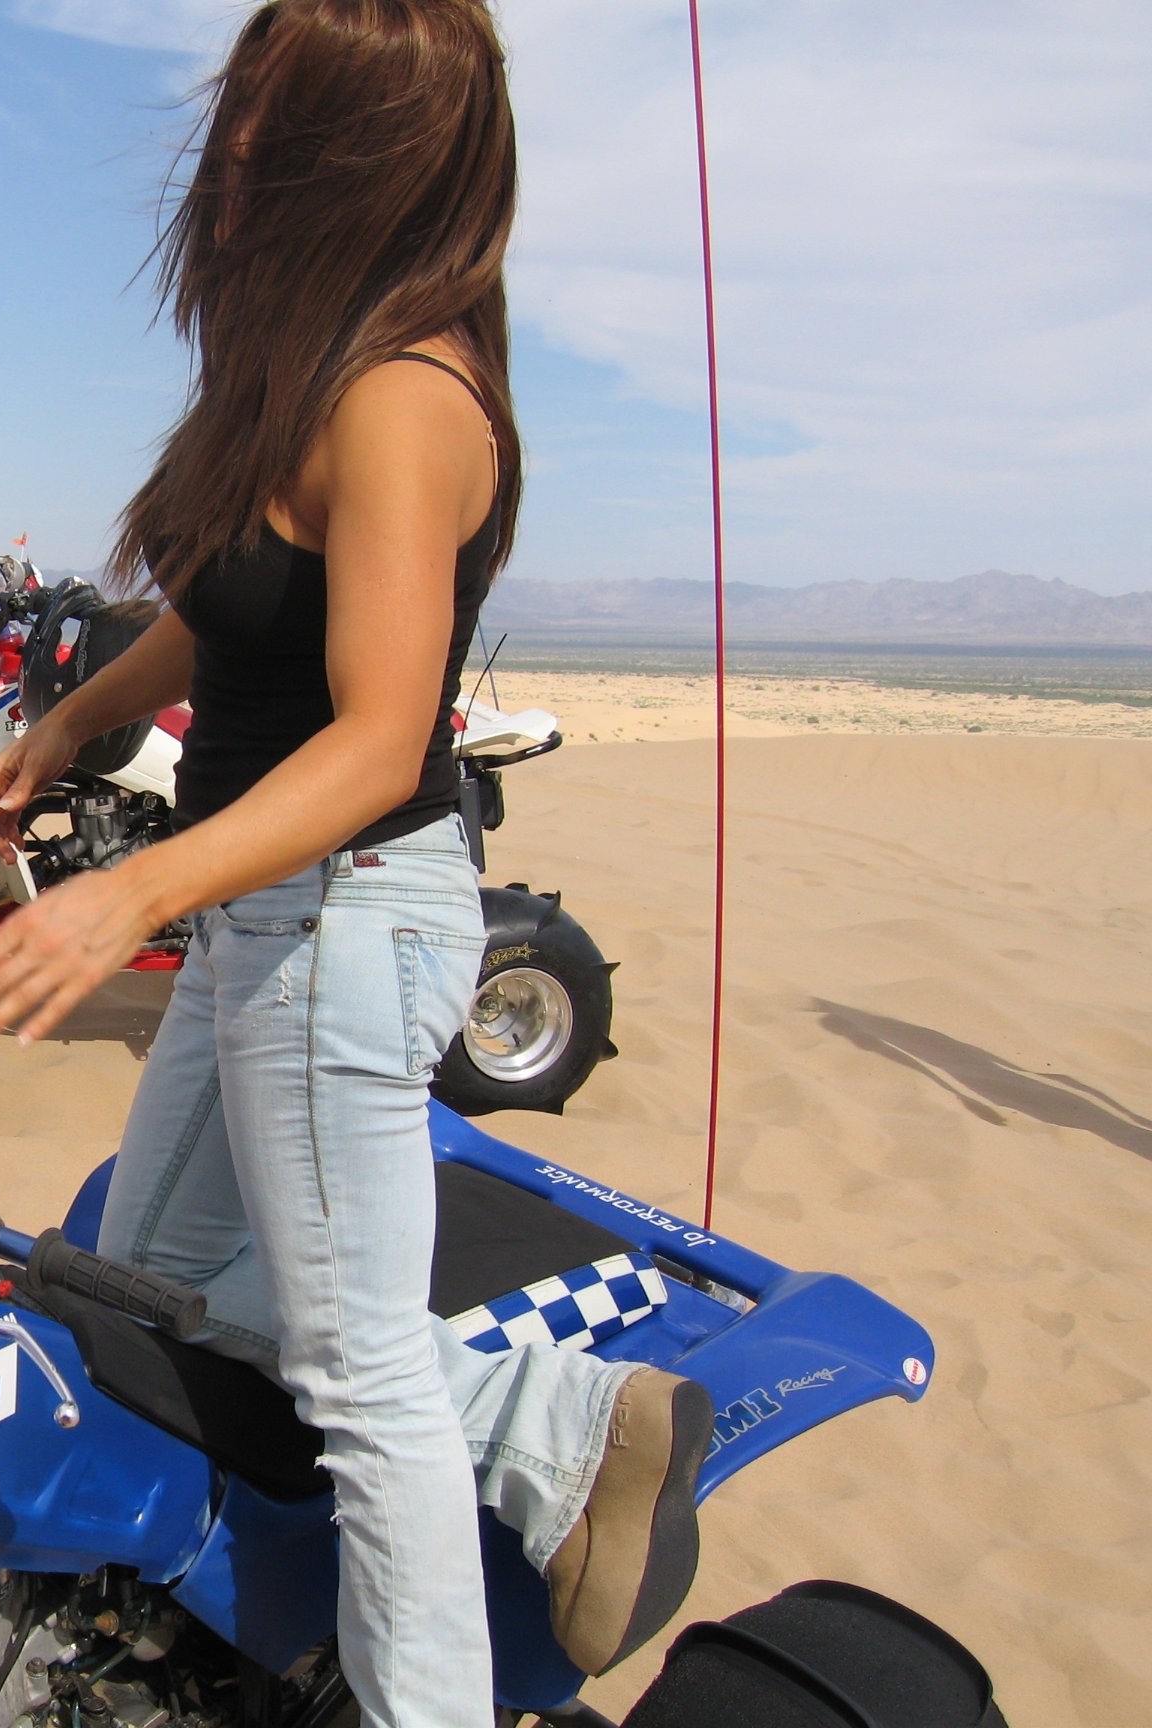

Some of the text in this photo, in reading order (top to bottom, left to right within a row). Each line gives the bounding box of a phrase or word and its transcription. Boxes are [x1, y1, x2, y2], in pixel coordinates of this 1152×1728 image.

[535, 1164, 717, 1248] JD PERFORMANCE
[703, 1387, 783, 1463] MI
[775, 1365, 847, 1397] Racing
